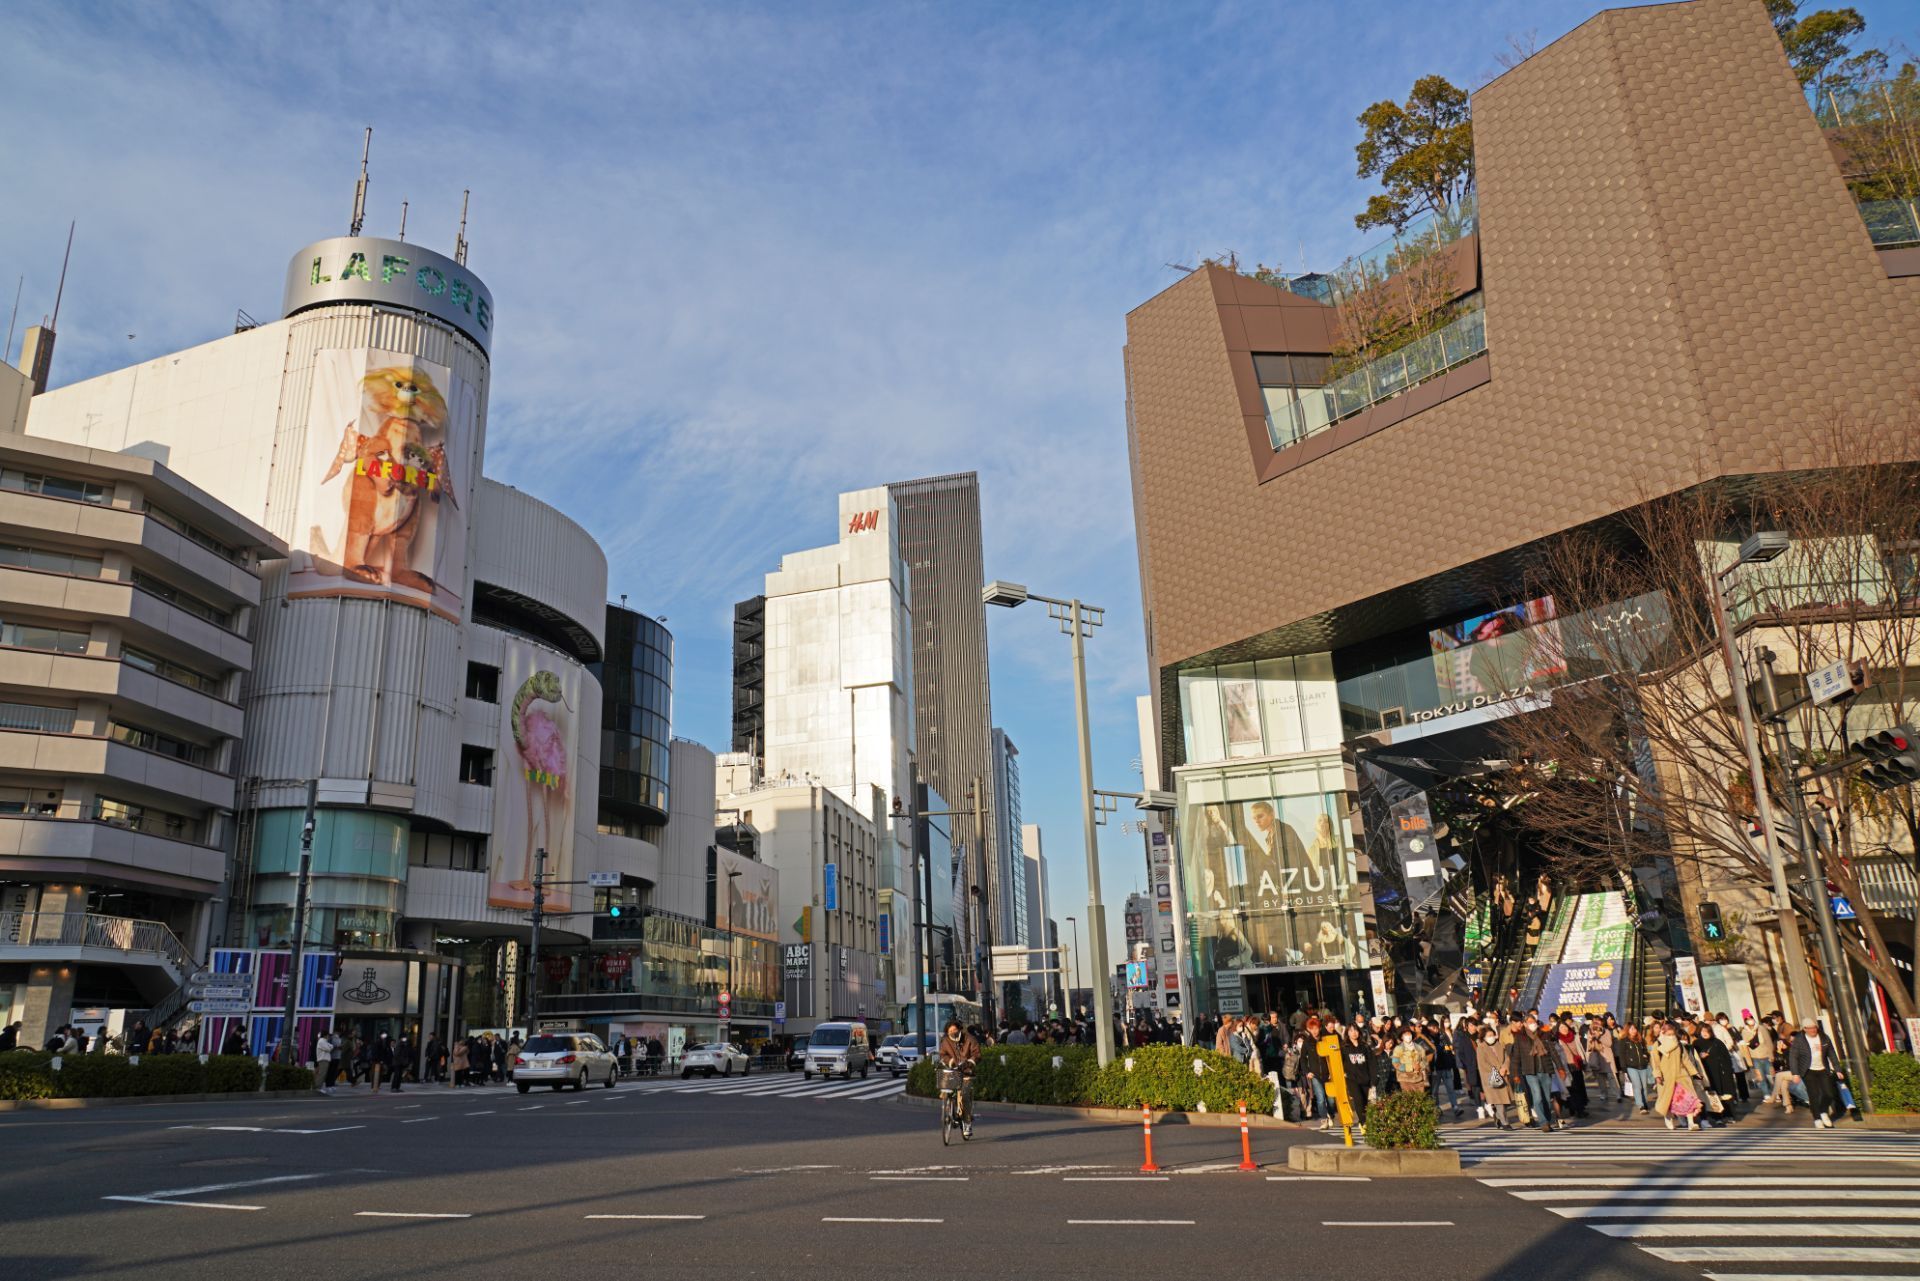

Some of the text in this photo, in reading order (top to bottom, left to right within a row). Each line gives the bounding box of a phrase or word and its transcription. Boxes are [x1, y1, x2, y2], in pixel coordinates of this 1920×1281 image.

[310, 252, 494, 329] LAFORE
[356, 457, 437, 491] LAFORET
[849, 510, 880, 534] H&M
[1269, 691, 1327, 705] JILLSUART
[1410, 685, 1534, 724] TOKYU PLAZA
[1399, 816, 1427, 831] bills
[1257, 865, 1350, 897] AZUL
[1263, 899, 1279, 908] BY
[786, 946, 809, 957] ABC
[606, 959, 627, 967] HUMAN
[786, 957, 809, 966] MART
[1222, 999, 1240, 1007] AZUL
[1558, 991, 1587, 1004] WEEK
[776, 1003, 784, 1012] P
